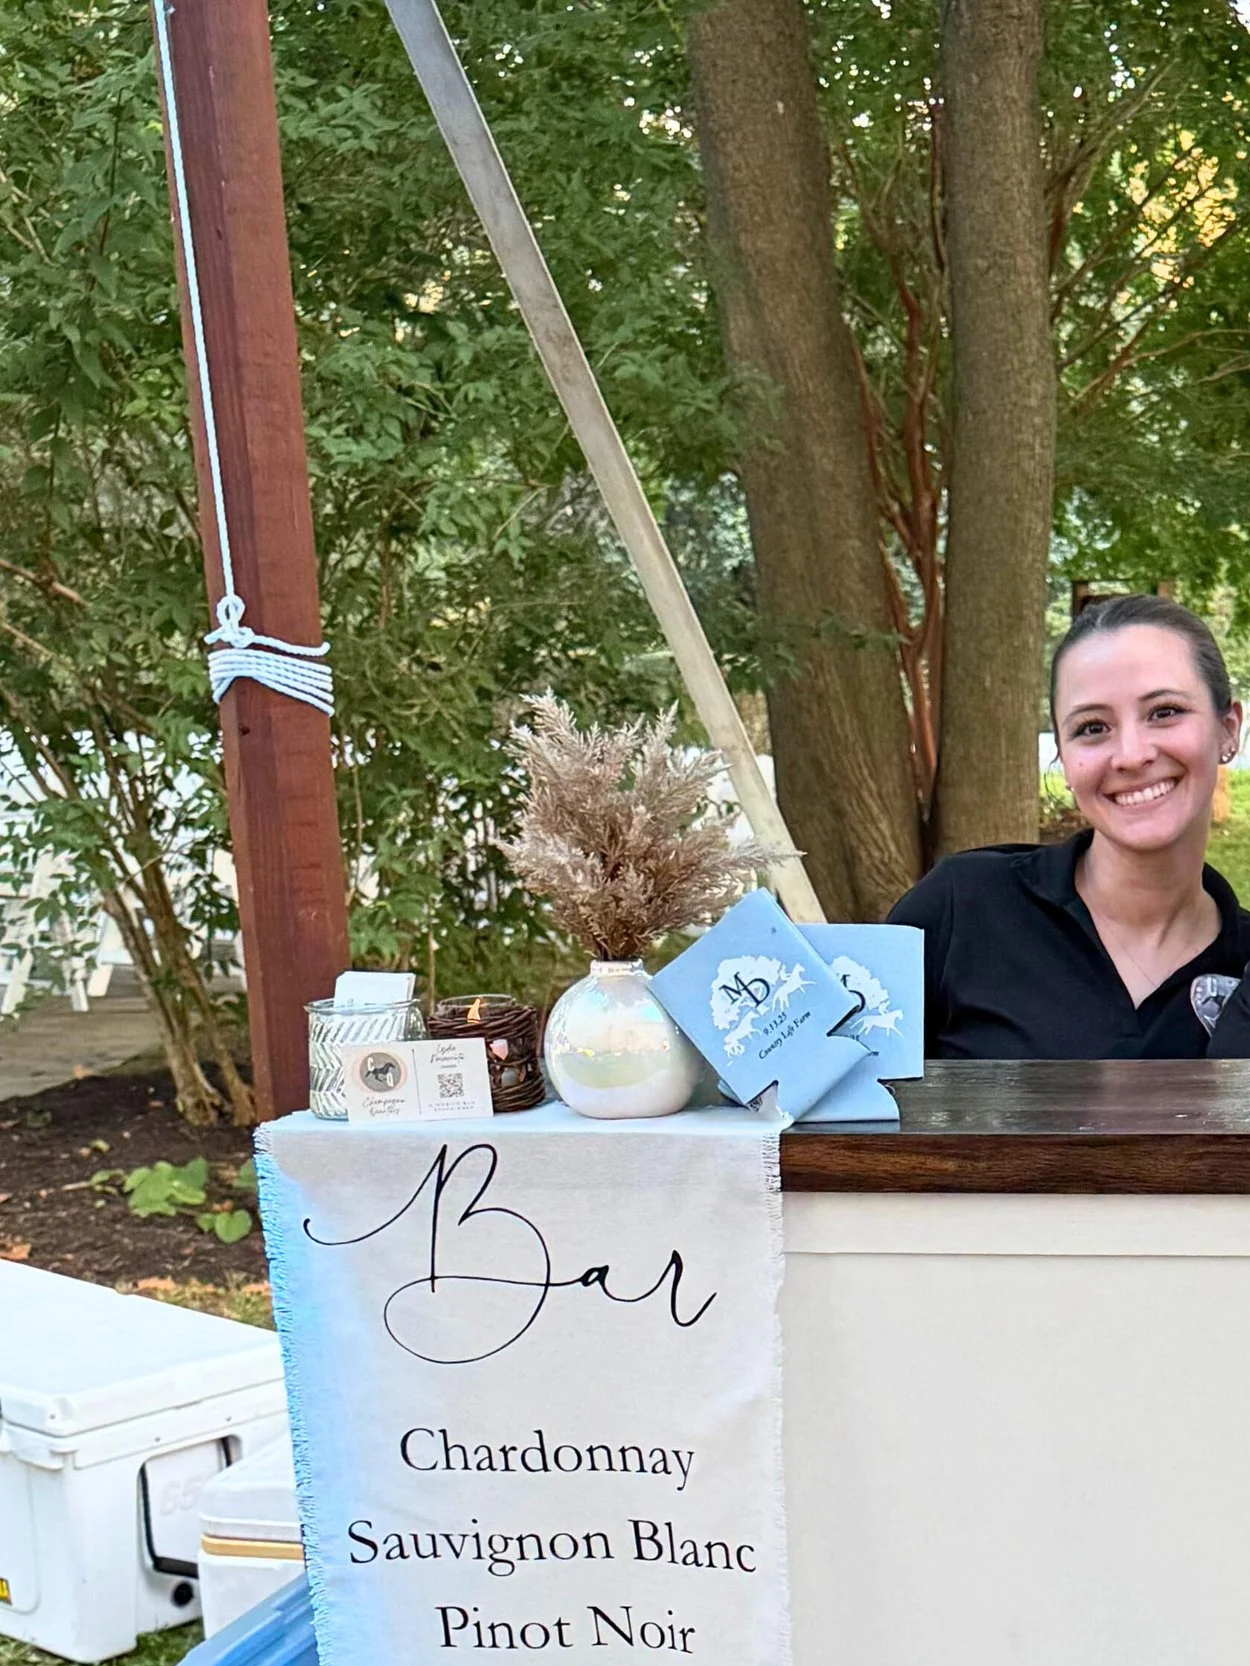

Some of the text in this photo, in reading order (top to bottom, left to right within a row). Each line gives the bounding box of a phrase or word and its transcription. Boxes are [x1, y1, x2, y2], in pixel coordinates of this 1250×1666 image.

[302, 1143, 718, 1365] Bar
[399, 1427, 695, 1492] Chardonnay
[347, 1518, 757, 1578] Sauvignon Blanc
[434, 1605, 696, 1655] Pinot Noir
